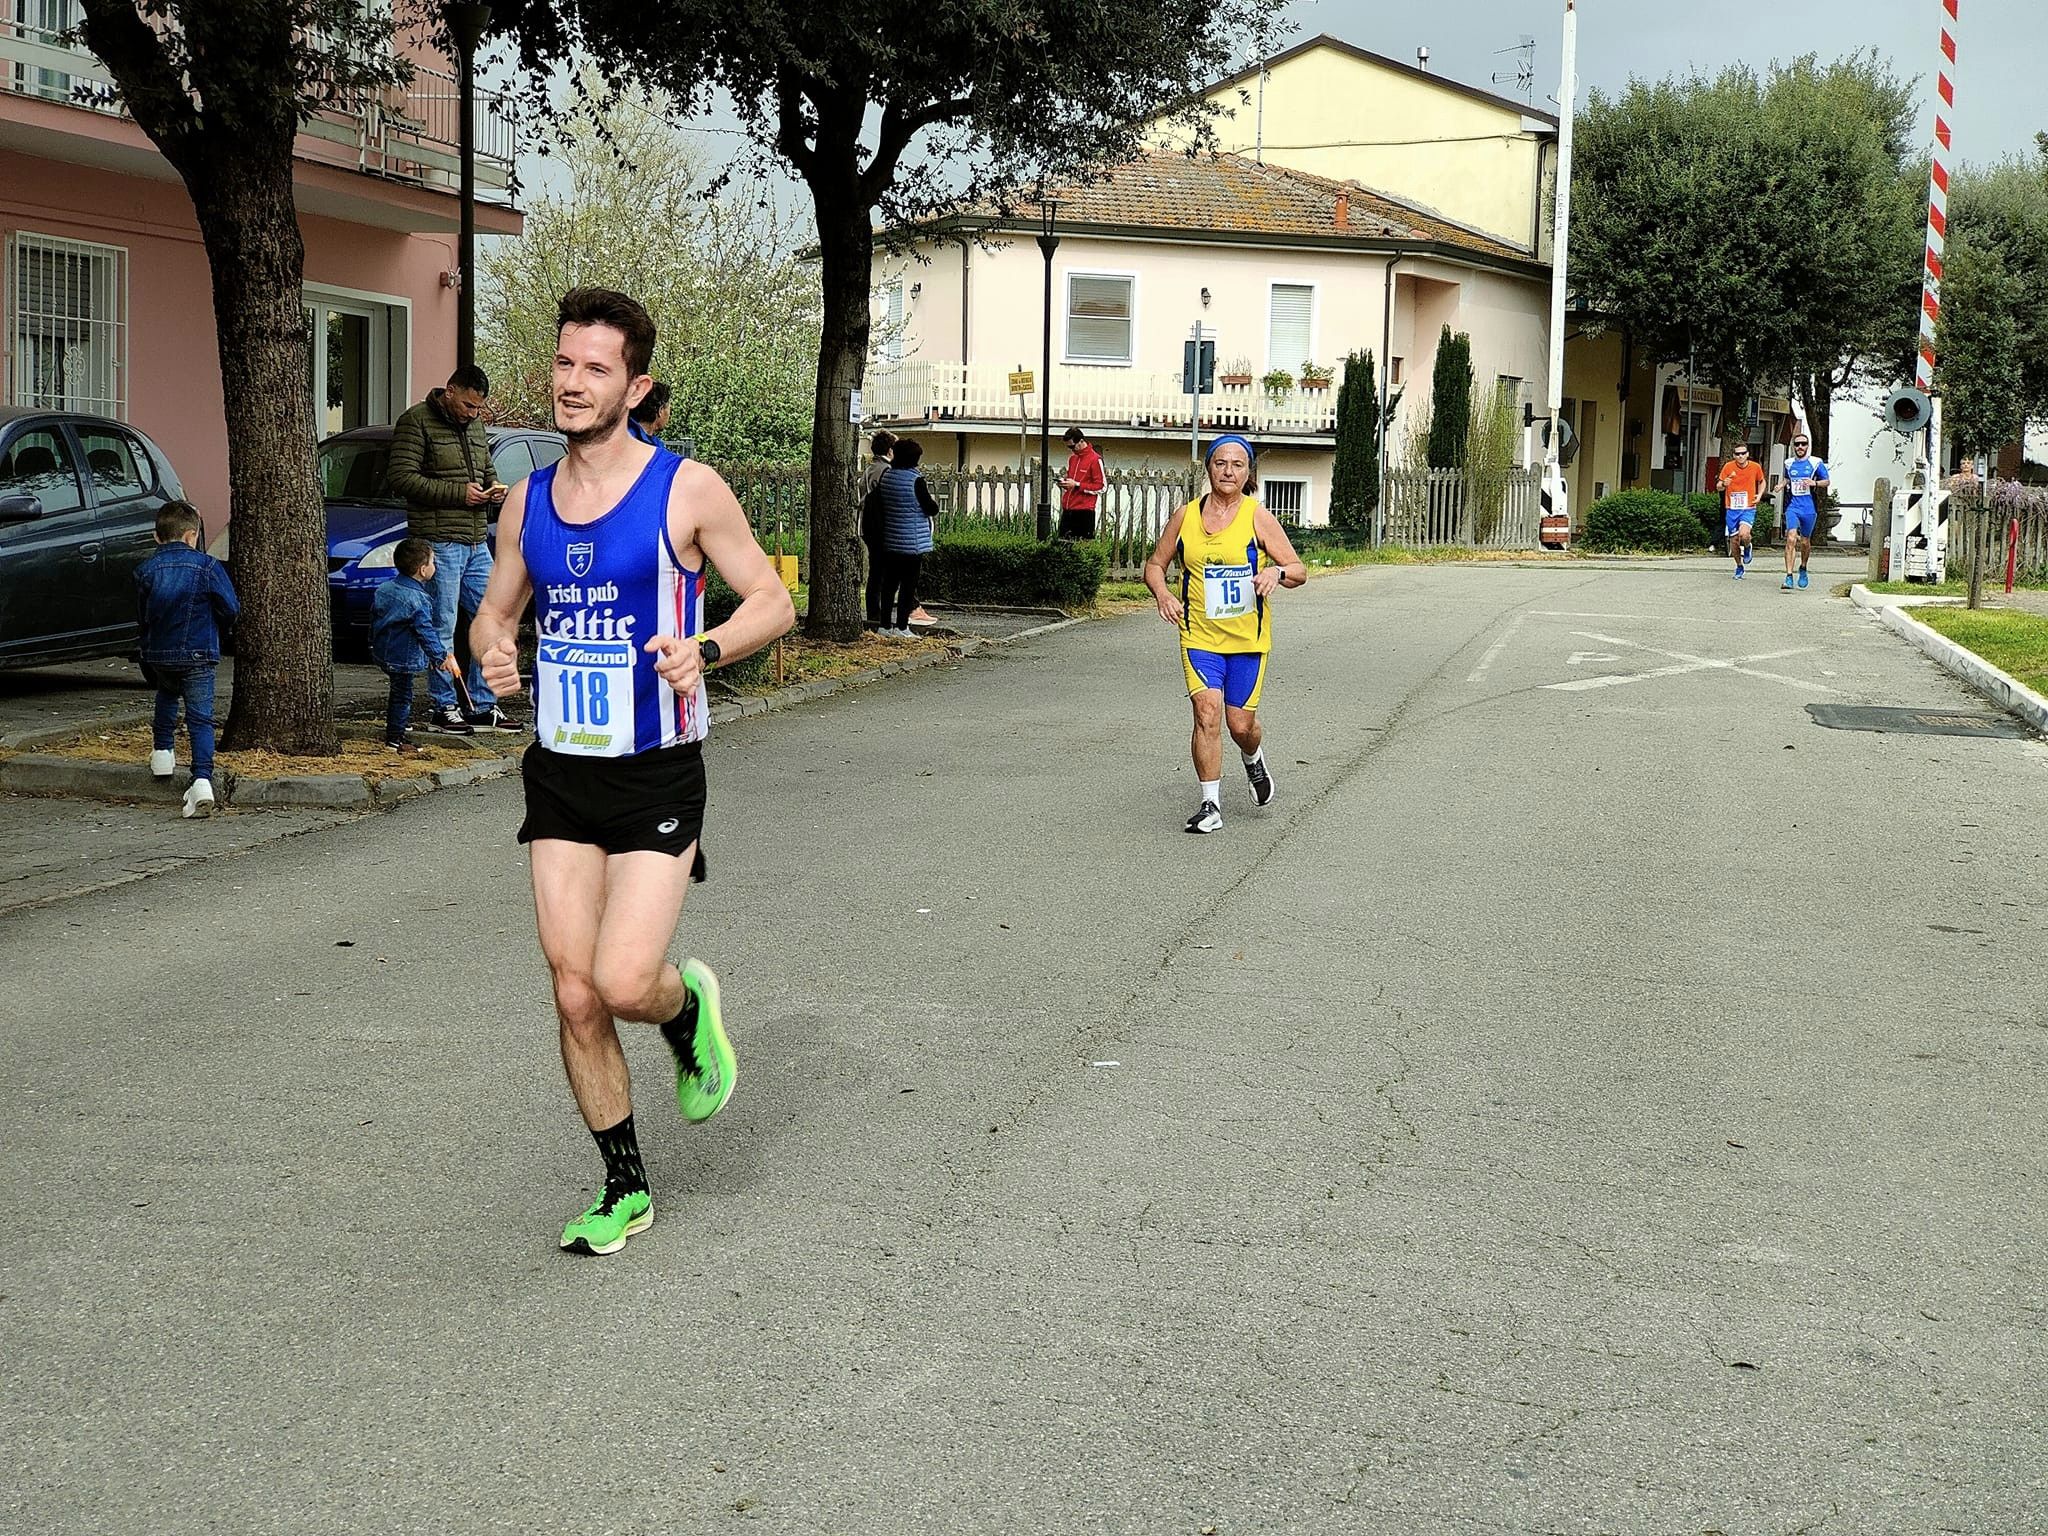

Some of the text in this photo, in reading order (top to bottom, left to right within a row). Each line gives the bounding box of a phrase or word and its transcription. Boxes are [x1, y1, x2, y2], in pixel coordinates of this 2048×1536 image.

[587, 581, 619, 607] pub
[1221, 580, 1241, 605] 15
[543, 608, 636, 640] Celtic
[559, 669, 609, 726] 118
